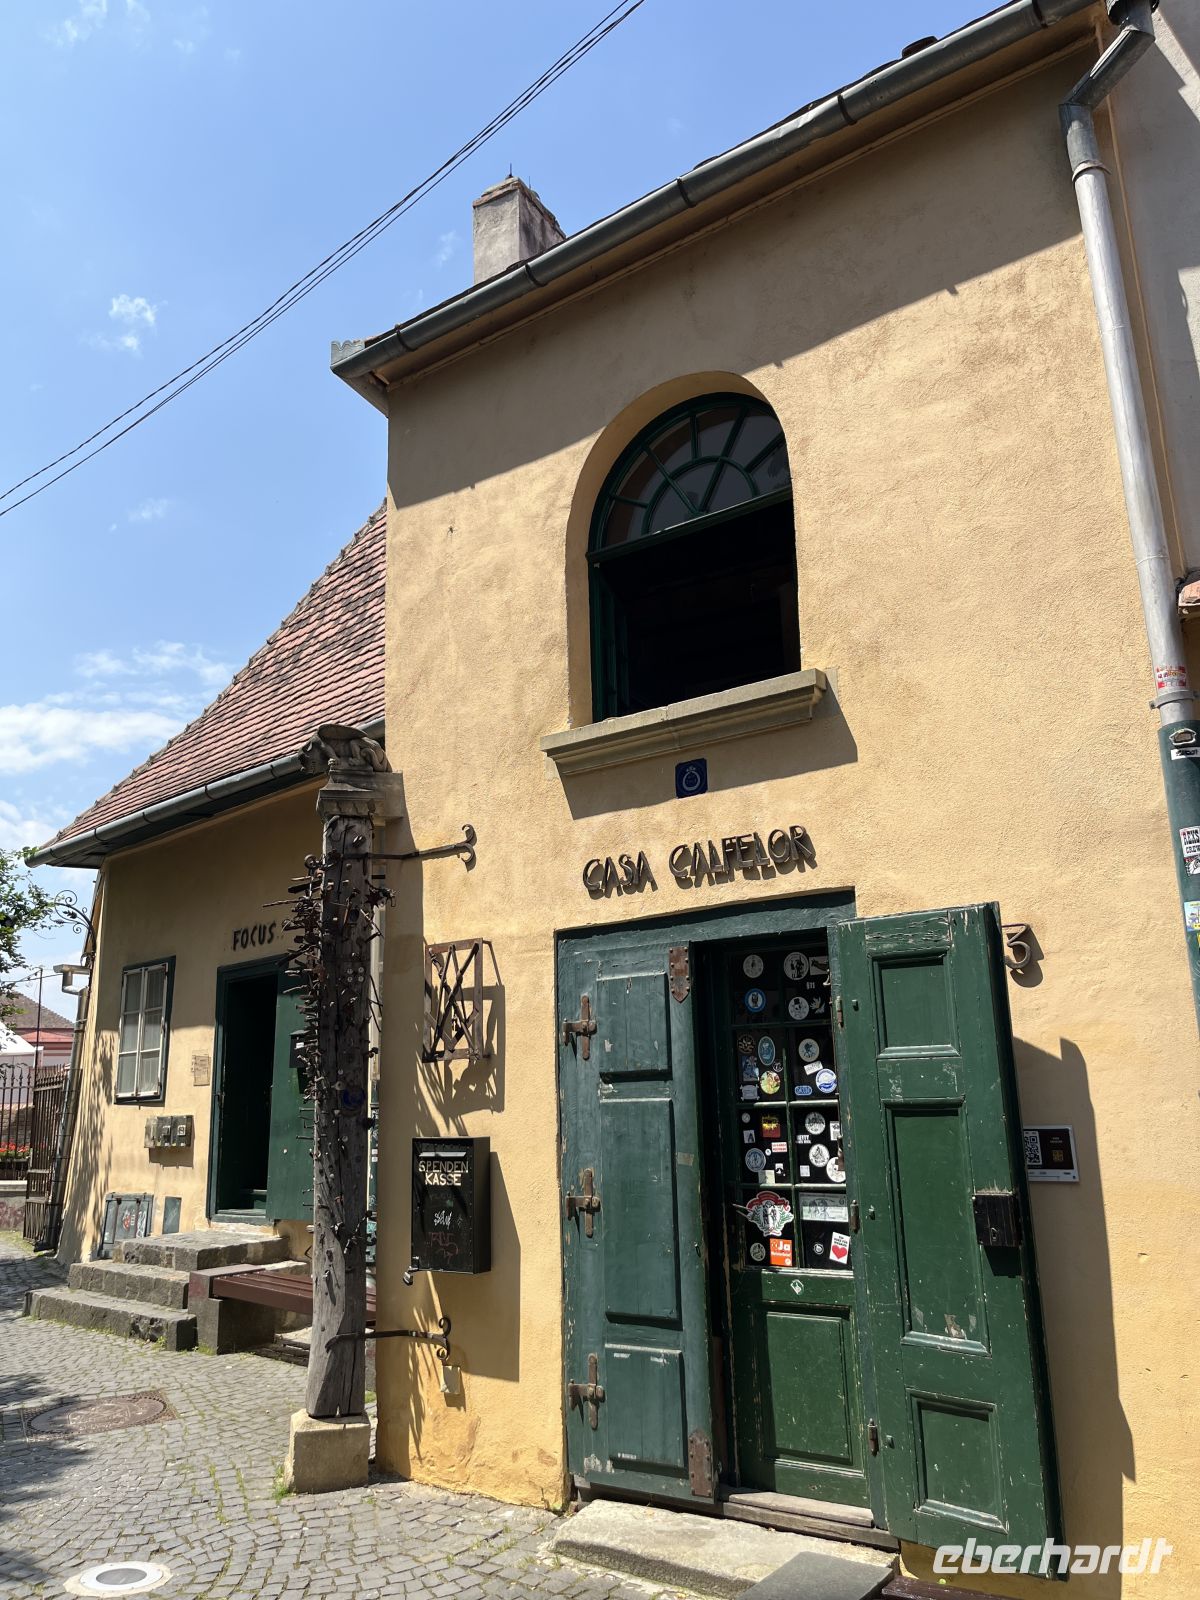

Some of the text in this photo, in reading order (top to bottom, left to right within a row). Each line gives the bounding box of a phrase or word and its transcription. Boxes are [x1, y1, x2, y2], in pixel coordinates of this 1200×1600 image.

[583, 825, 813, 891] CASA CALFELOR
[233, 922, 277, 951] FOCUS
[1002, 923, 1032, 969] 3
[418, 1160, 469, 1174] SPENDEN
[425, 1173, 462, 1186] KASSE
